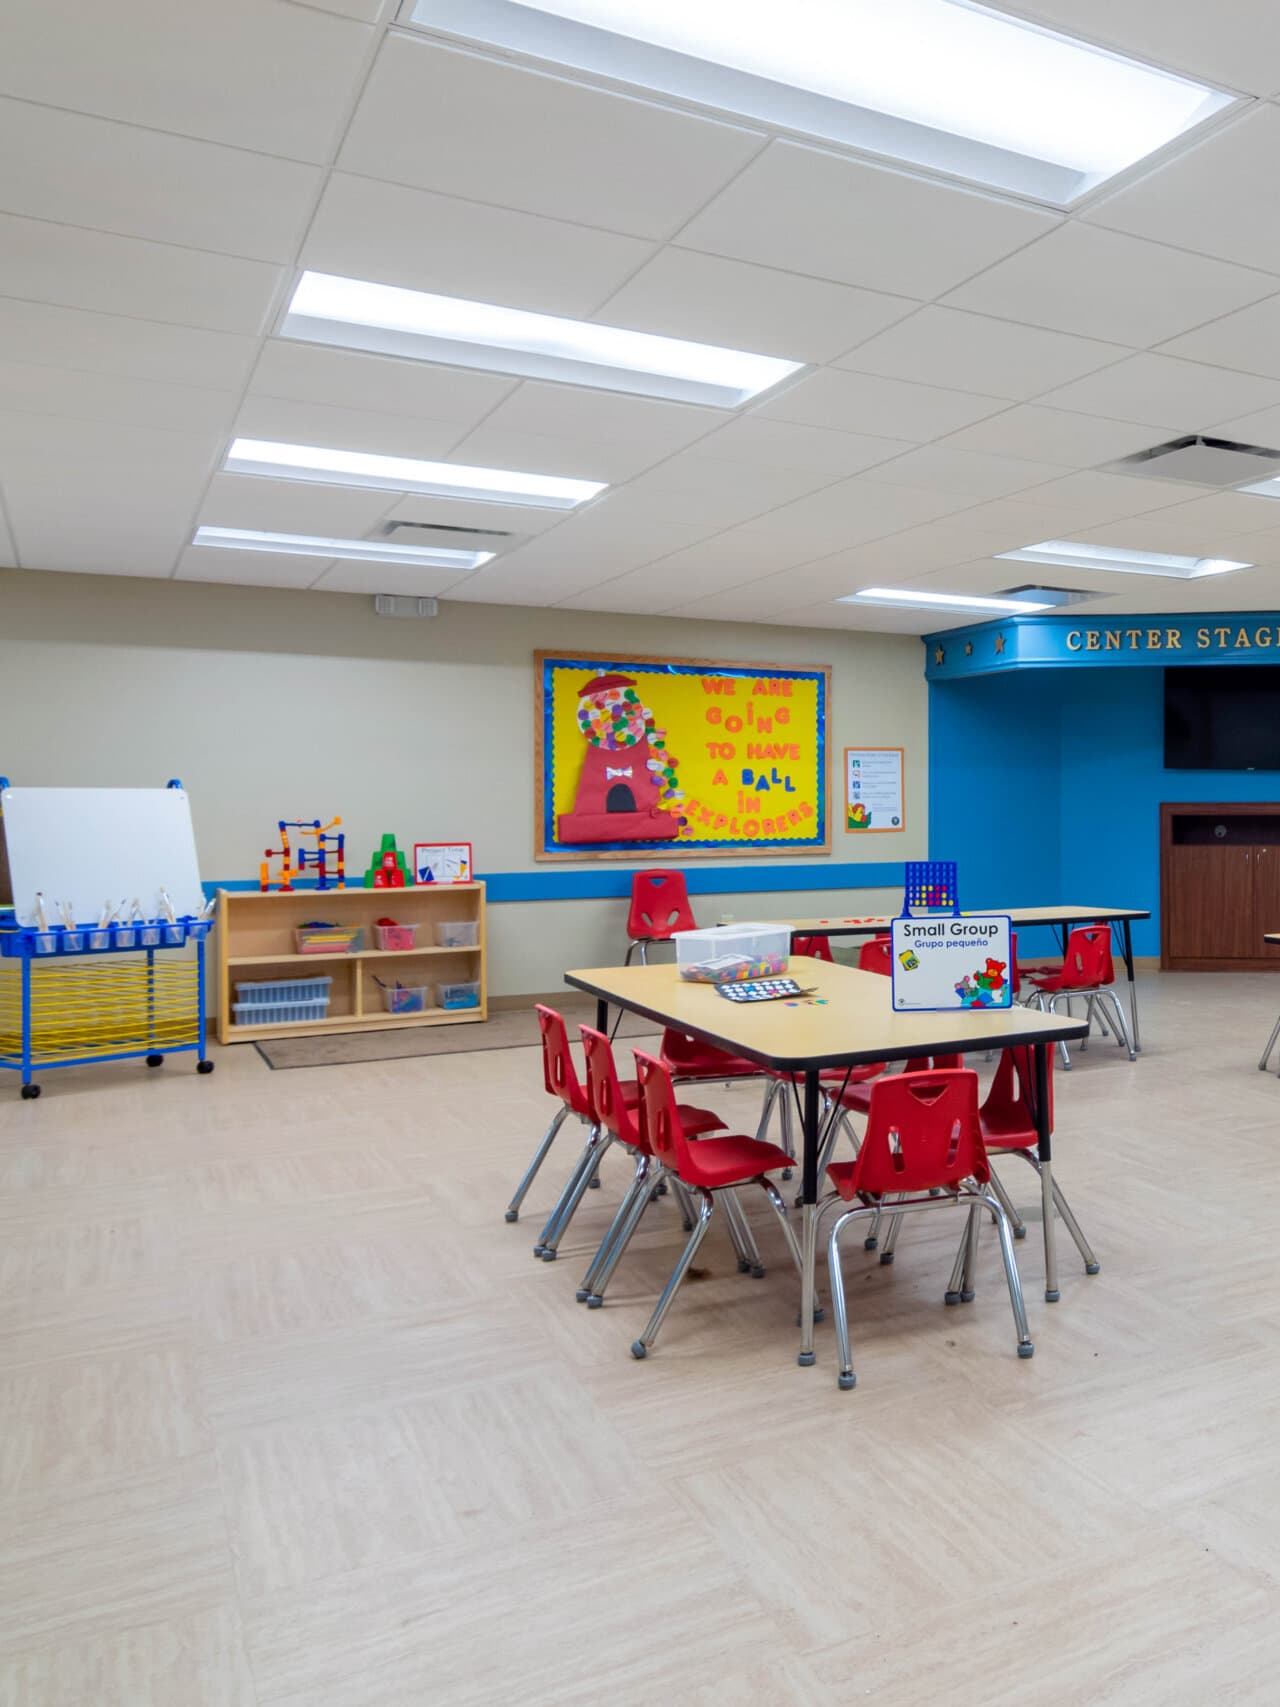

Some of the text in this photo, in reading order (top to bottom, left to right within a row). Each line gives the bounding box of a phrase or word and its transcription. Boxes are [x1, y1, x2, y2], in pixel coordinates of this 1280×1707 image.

[1066, 628, 1182, 650] CENTER
[701, 678, 793, 697] WE ARE
[705, 742, 800, 760] TO HAVE
[712, 767, 796, 792] A BALL
[685, 799, 813, 837] EXPLORERS
[904, 923, 998, 937] Small Group
[914, 938, 988, 949] Grupo pequeño
